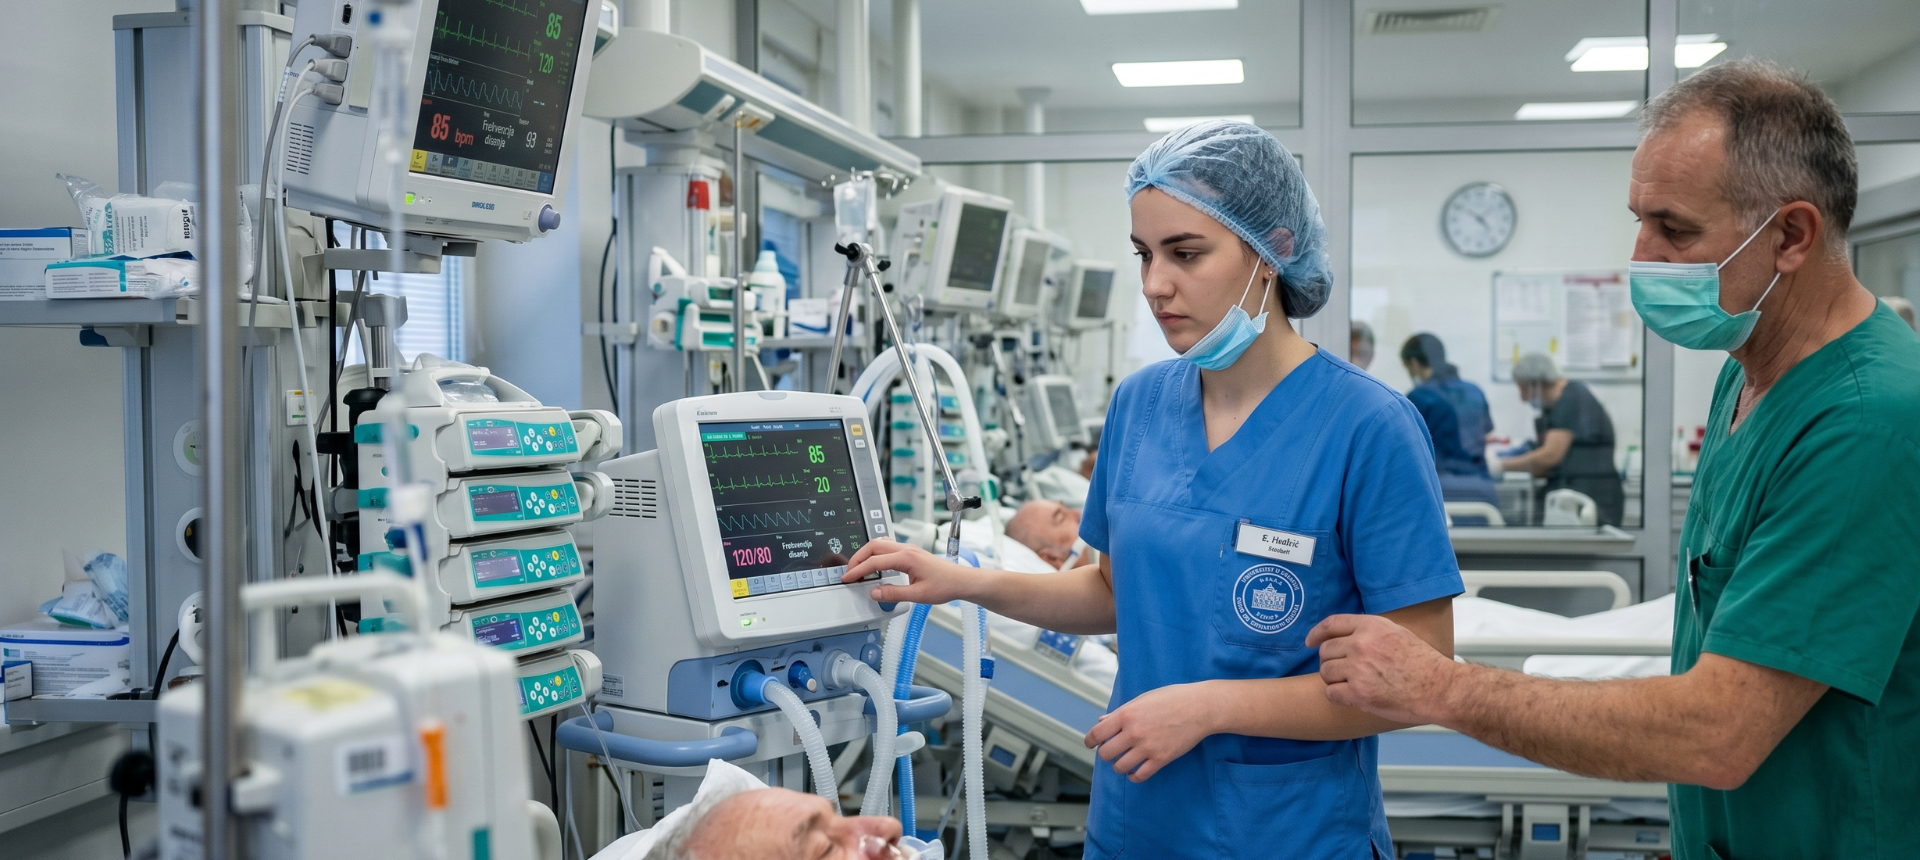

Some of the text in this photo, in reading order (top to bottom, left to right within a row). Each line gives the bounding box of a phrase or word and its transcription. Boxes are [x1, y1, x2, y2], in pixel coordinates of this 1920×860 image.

[545, 12, 563, 40] 85
[538, 52, 554, 74] 120
[430, 113, 474, 147] 85 bpm
[525, 131, 537, 149] 93
[808, 445, 825, 464] 85
[814, 476, 830, 493] 20
[732, 546, 772, 567] 120/80
